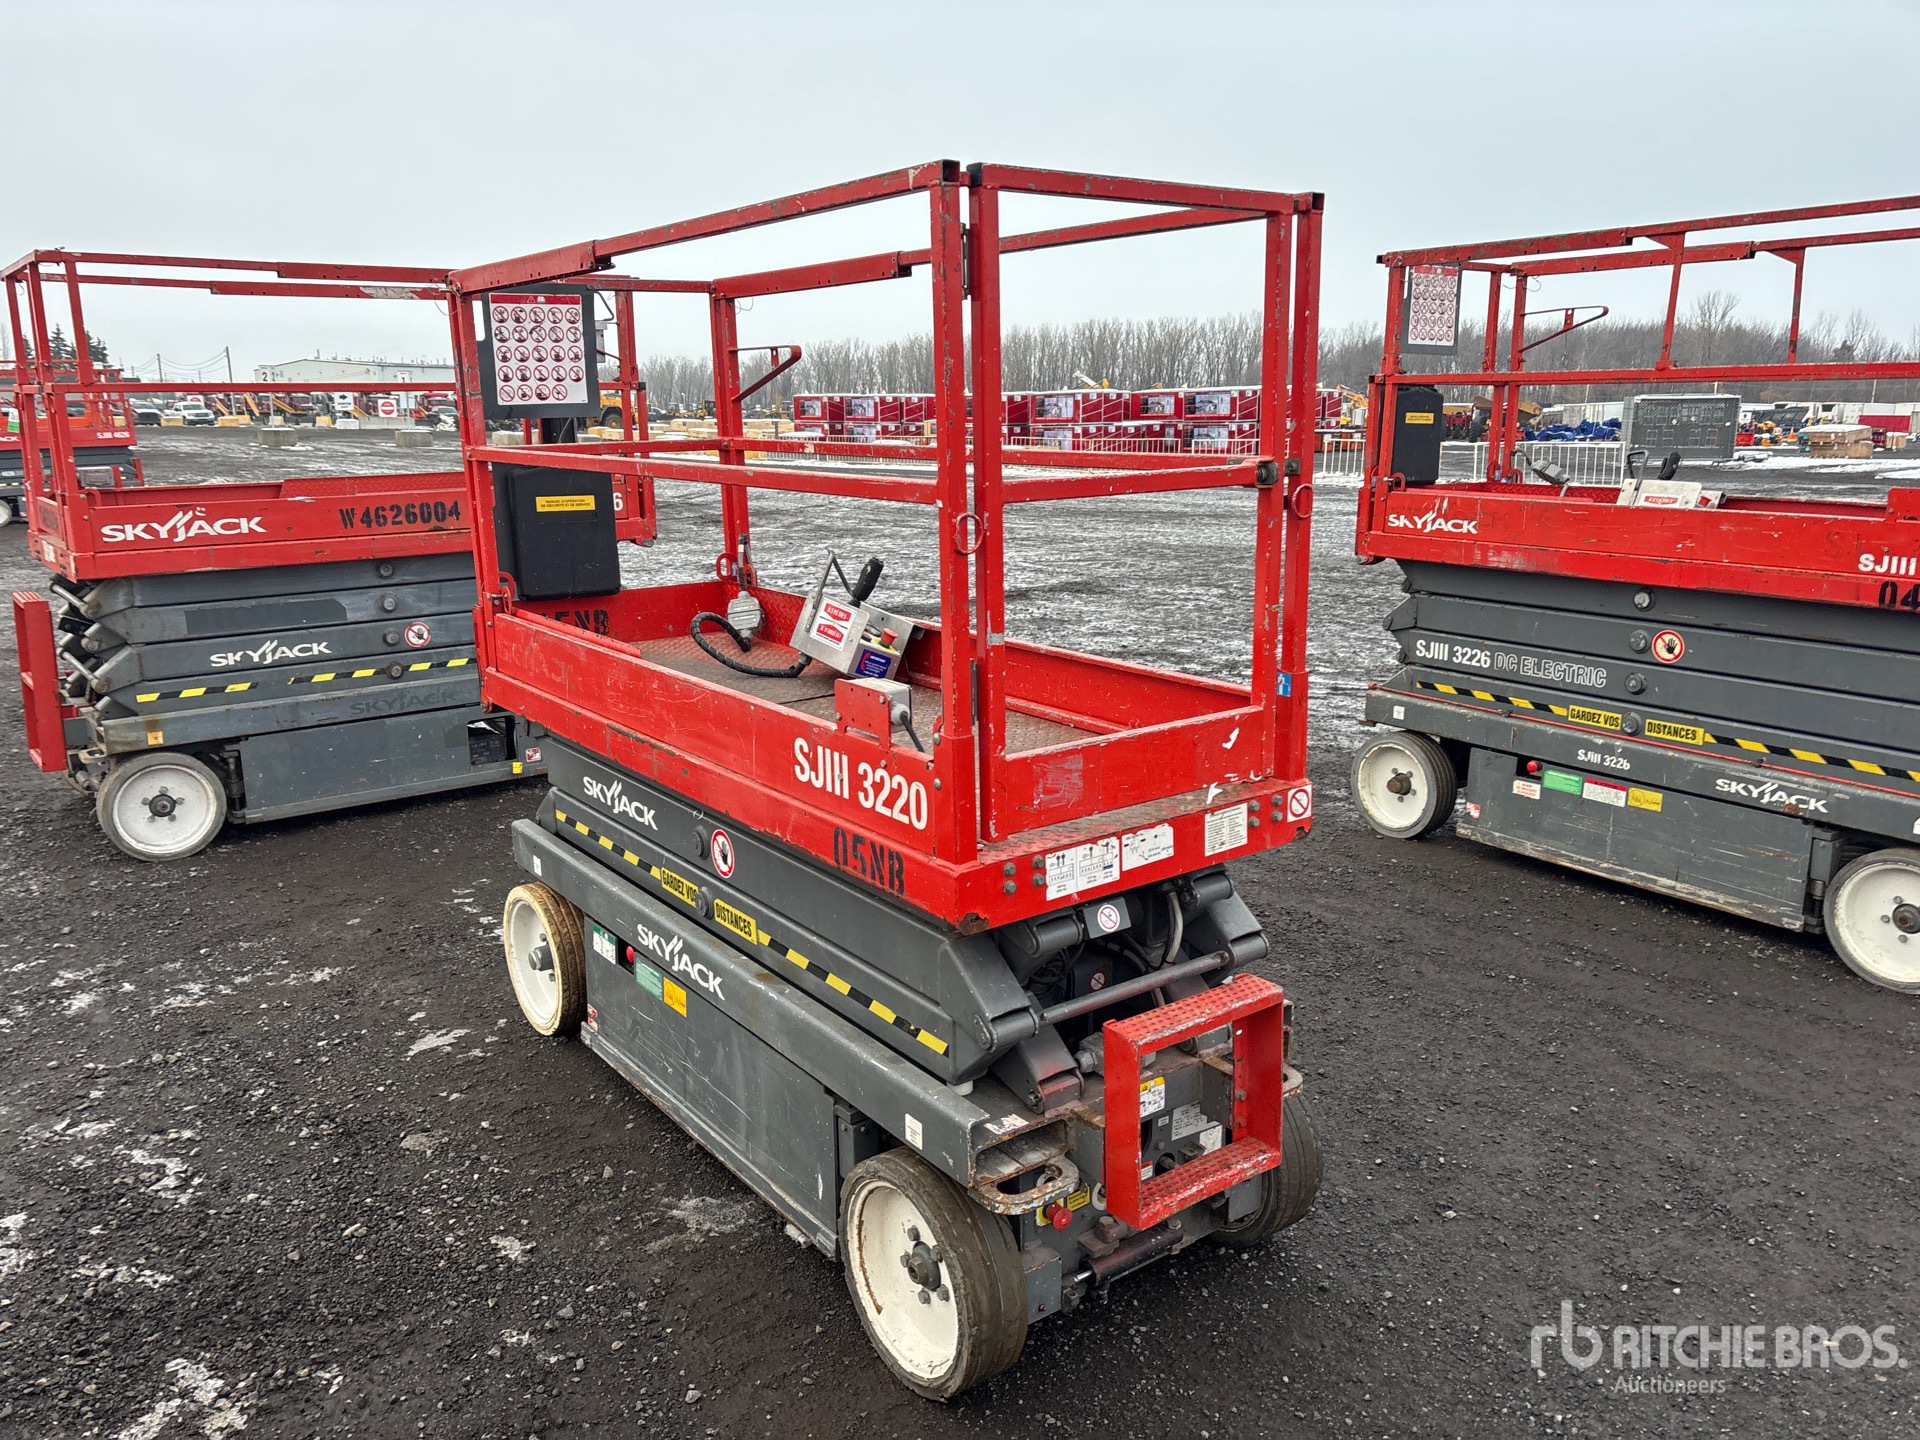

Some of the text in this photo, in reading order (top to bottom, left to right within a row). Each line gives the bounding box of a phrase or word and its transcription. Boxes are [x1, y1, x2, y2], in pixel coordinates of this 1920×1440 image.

[101, 510, 268, 542] SKYJACK
[1387, 509, 1478, 535] SKYJACK
[1858, 553, 1917, 576] SJIII
[209, 640, 332, 667] SKYJACK
[1415, 639, 1607, 688] SJIII 3226 DC ELECTRIC
[1570, 708, 1698, 742] GARDEZ VOS DISTANCES
[1603, 754, 1631, 771] 3226
[583, 776, 659, 831] SKYJACK
[857, 761, 928, 831] 3220
[1715, 778, 1829, 814] SKYJACK
[662, 869, 685, 897] GARDEZ
[715, 902, 753, 938] DISTANCES
[637, 923, 726, 1001] SKYJACK
